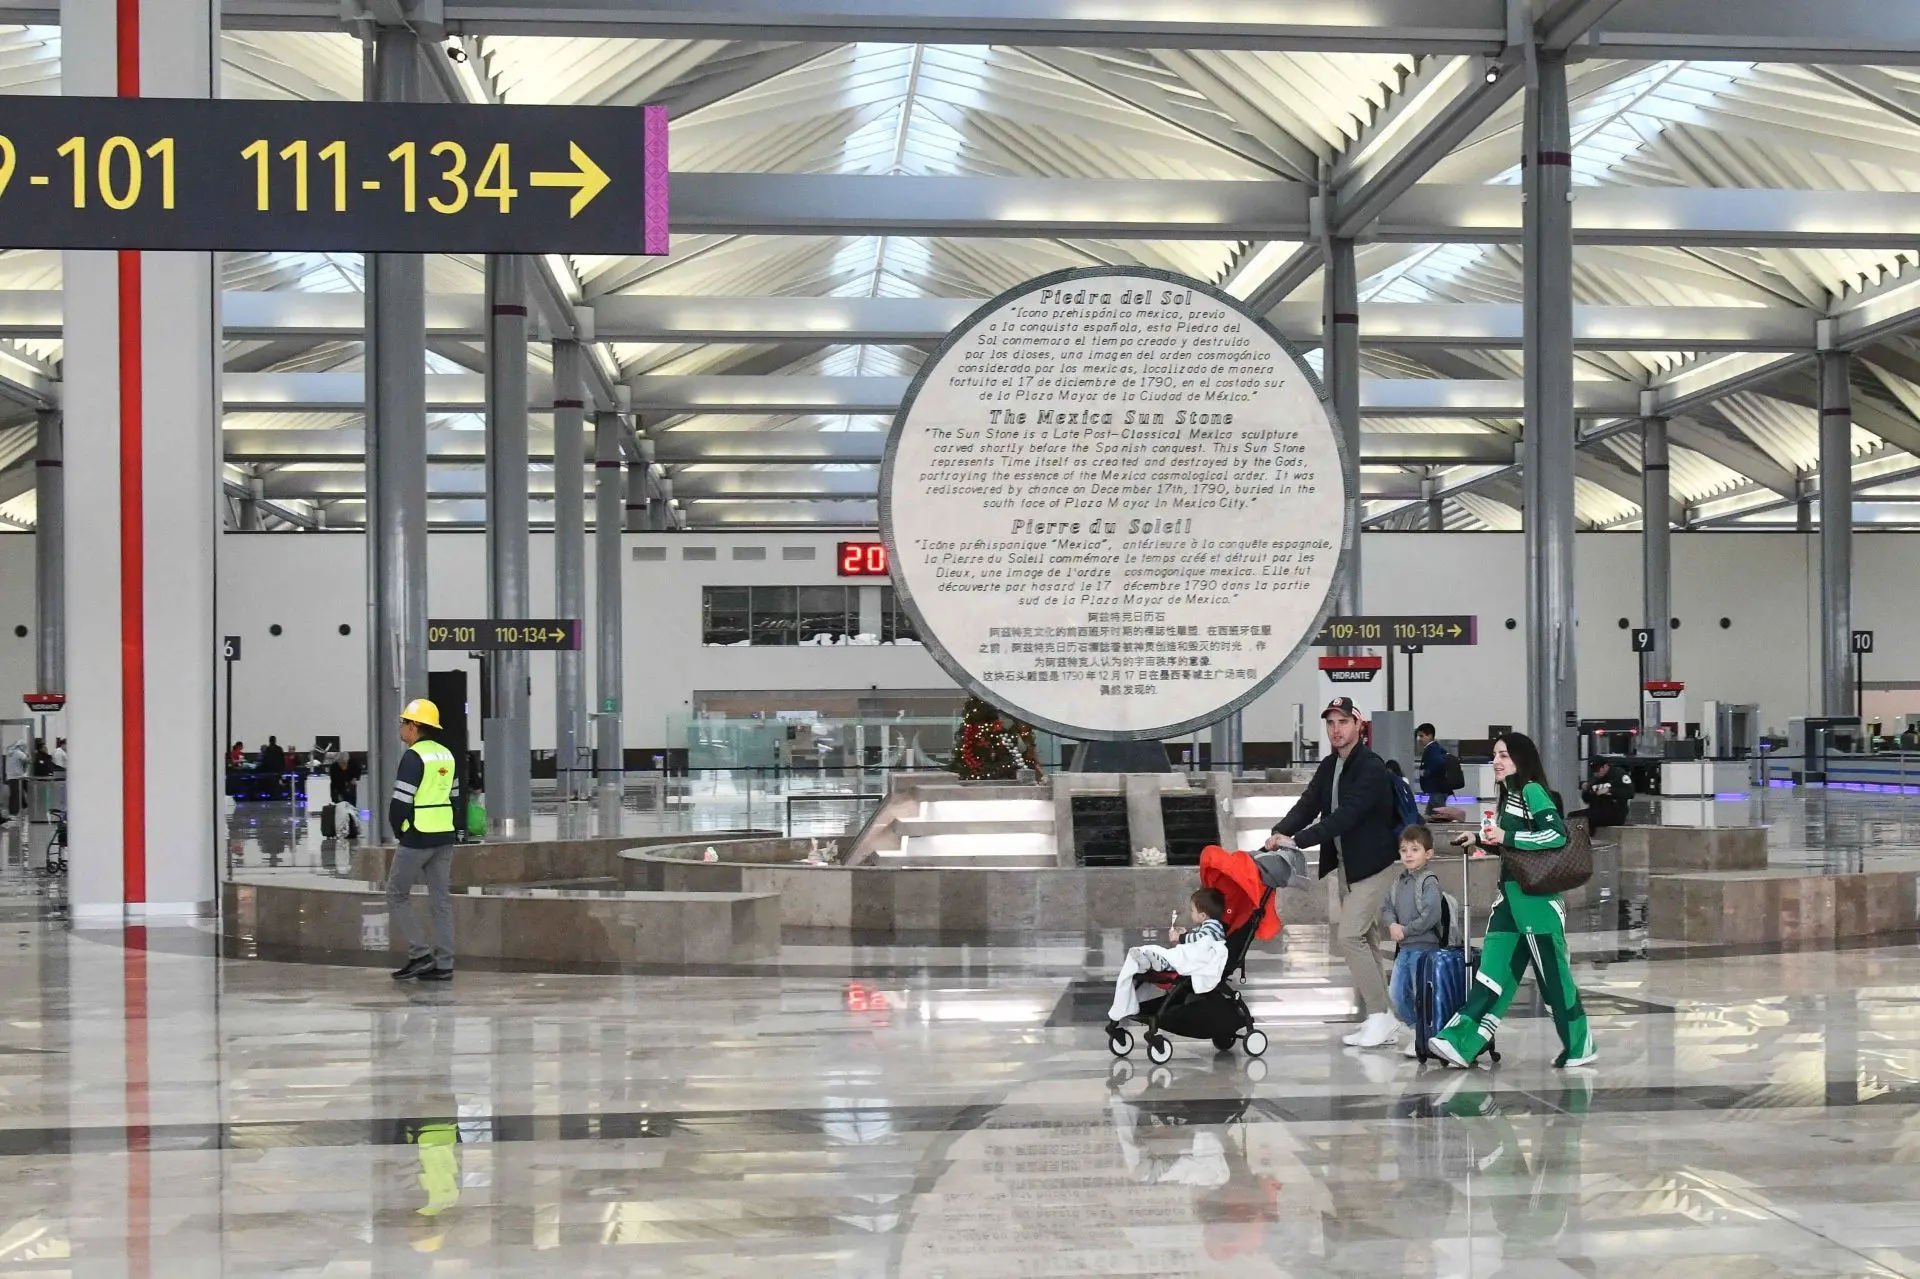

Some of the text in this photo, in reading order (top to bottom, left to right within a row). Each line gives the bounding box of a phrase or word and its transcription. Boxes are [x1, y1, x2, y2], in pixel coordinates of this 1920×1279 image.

[241, 140, 517, 215] 111-134
[1041, 290, 1193, 305] Piedra del Sol
[1052, 307, 1132, 320] prehispánico
[1189, 310, 1226, 320] previo
[1020, 322, 1078, 333] conquista
[1147, 323, 1172, 332] esta
[1177, 322, 1218, 332] Piedra
[1223, 323, 1240, 332] del
[978, 335, 997, 345] Sol
[1092, 336, 1133, 347] tiempo
[1137, 337, 1176, 346] creado
[1193, 337, 1250, 346] destruido
[964, 352, 986, 360] por
[1088, 350, 1132, 361] imagen
[1137, 350, 1154, 359] del
[1160, 351, 1192, 359] orden
[1197, 350, 1270, 362] cosmogónico
[958, 363, 1032, 373] considerado
[1035, 366, 1055, 374] por
[1143, 364, 1207, 375] localizado
[1211, 365, 1224, 373] de
[949, 377, 997, 386] fortuita
[1018, 376, 1034, 387] 17
[1037, 377, 1051, 386] de
[1055, 377, 1117, 387] diciembre
[1122, 377, 1136, 387] de
[1216, 378, 1260, 387] costado
[979, 391, 993, 400] de
[1016, 390, 1053, 400] Plaza
[1059, 390, 1098, 402] Mayor
[1103, 392, 1116, 400] de
[1140, 390, 1182, 401] Ciudad
[1187, 392, 1200, 401] de
[990, 409, 1233, 424] The Mexica Sun Stone
[956, 428, 980, 439] Sun
[985, 428, 1019, 439] Stone
[1053, 428, 1079, 439] Late
[1084, 428, 1181, 439] Post-Classical
[1188, 428, 1232, 440] Mexica
[1241, 430, 1299, 441] sculpture
[934, 443, 974, 452] carved
[980, 443, 1024, 454] shortly
[1029, 443, 1067, 452] before
[1072, 442, 1089, 452] the
[1096, 442, 1147, 455] Spanish
[1213, 442, 1238, 453] This
[1244, 442, 1267, 453] Sun
[1273, 443, 1305, 453] Stone
[930, 457, 994, 468] represents
[1001, 456, 1030, 466] Time
[1035, 457, 1069, 466] itself
[1092, 457, 1140, 466] created
[1144, 457, 1165, 466] and
[1171, 457, 1228, 468] destroyed
[1234, 457, 1248, 468] by
[1254, 457, 1271, 466] the
[919, 471, 987, 482] portraying
[992, 471, 1010, 480] the
[1063, 471, 1075, 480] of
[1080, 471, 1097, 480] the
[1101, 470, 1146, 480] Mexica
[1151, 471, 1228, 482] cosmological
[926, 485, 1003, 494] rediscovered
[1008, 485, 1022, 496] by
[1028, 485, 1069, 494] chance
[1090, 484, 1152, 494] December
[1235, 484, 1274, 494] buried
[1298, 485, 1315, 493] the
[983, 498, 1015, 508] south
[1021, 499, 1045, 508] face
[1049, 499, 1060, 507] of
[1064, 497, 1102, 508] Plaza
[1108, 497, 1150, 510] Mayor
[1173, 498, 1215, 508] Mexico
[1011, 518, 1192, 534] Pierre du Soleil
[960, 539, 1047, 551] préhispanique
[1123, 539, 1186, 551] antérieure
[1219, 539, 1268, 551] conquête
[844, 546, 885, 571] 20
[943, 552, 1314, 564] Pierre du Soleil commémore temps créé détruit par les
[1006, 568, 1043, 579] image
[1047, 568, 1061, 577] de
[1066, 568, 1110, 577] l'ordre
[1124, 567, 1206, 579] cosmogonique
[1262, 565, 1290, 576] Elle
[1294, 566, 1310, 575] fut
[938, 580, 1310, 592] découverte par hasard 17 décembre 1790 dans partie
[1017, 596, 1040, 606] sud
[1045, 596, 1058, 605] de
[1081, 594, 1119, 605] Plaza
[1124, 594, 1164, 606] Mayor
[1168, 595, 1182, 604] de
[495, 627, 547, 643] 110-134
[1329, 624, 1444, 639] 109-101 110-134
[1638, 632, 1648, 648] 9
[1853, 633, 1871, 650] 10
[1332, 671, 1370, 680] HIDRANTE
